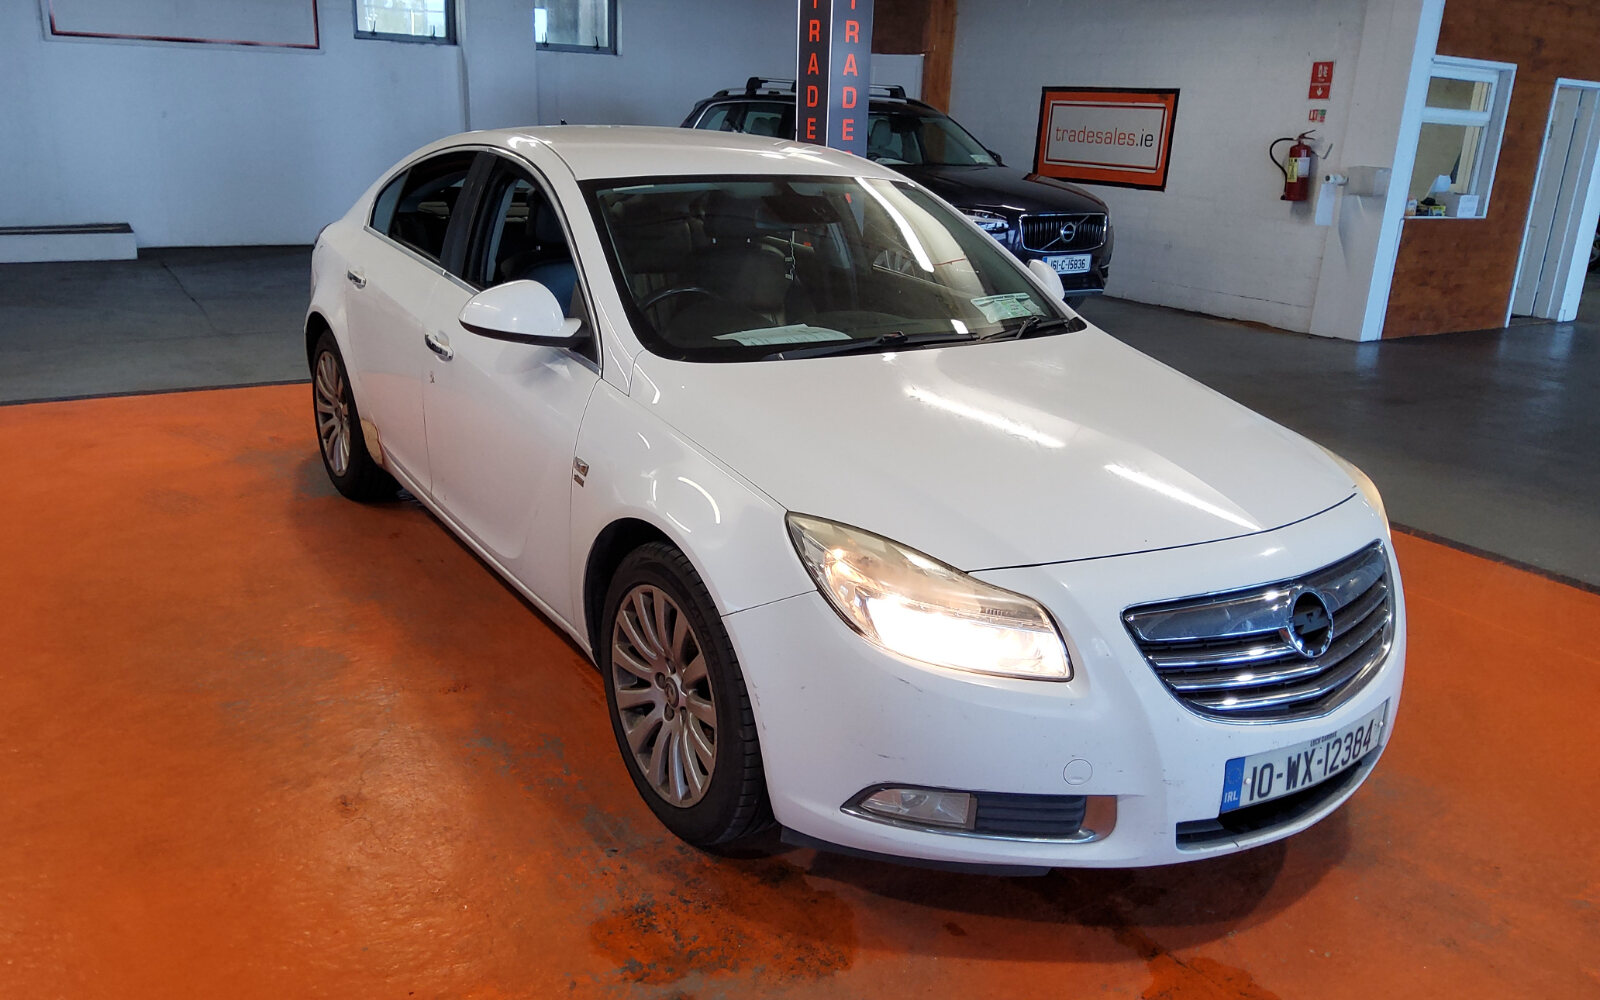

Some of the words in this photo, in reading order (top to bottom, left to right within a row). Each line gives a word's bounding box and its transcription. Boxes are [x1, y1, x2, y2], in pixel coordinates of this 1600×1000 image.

[1055, 125, 1154, 148] tradesales.ie
[1249, 719, 1376, 802] 10-WX-12384
[1224, 790, 1239, 804] IRL
